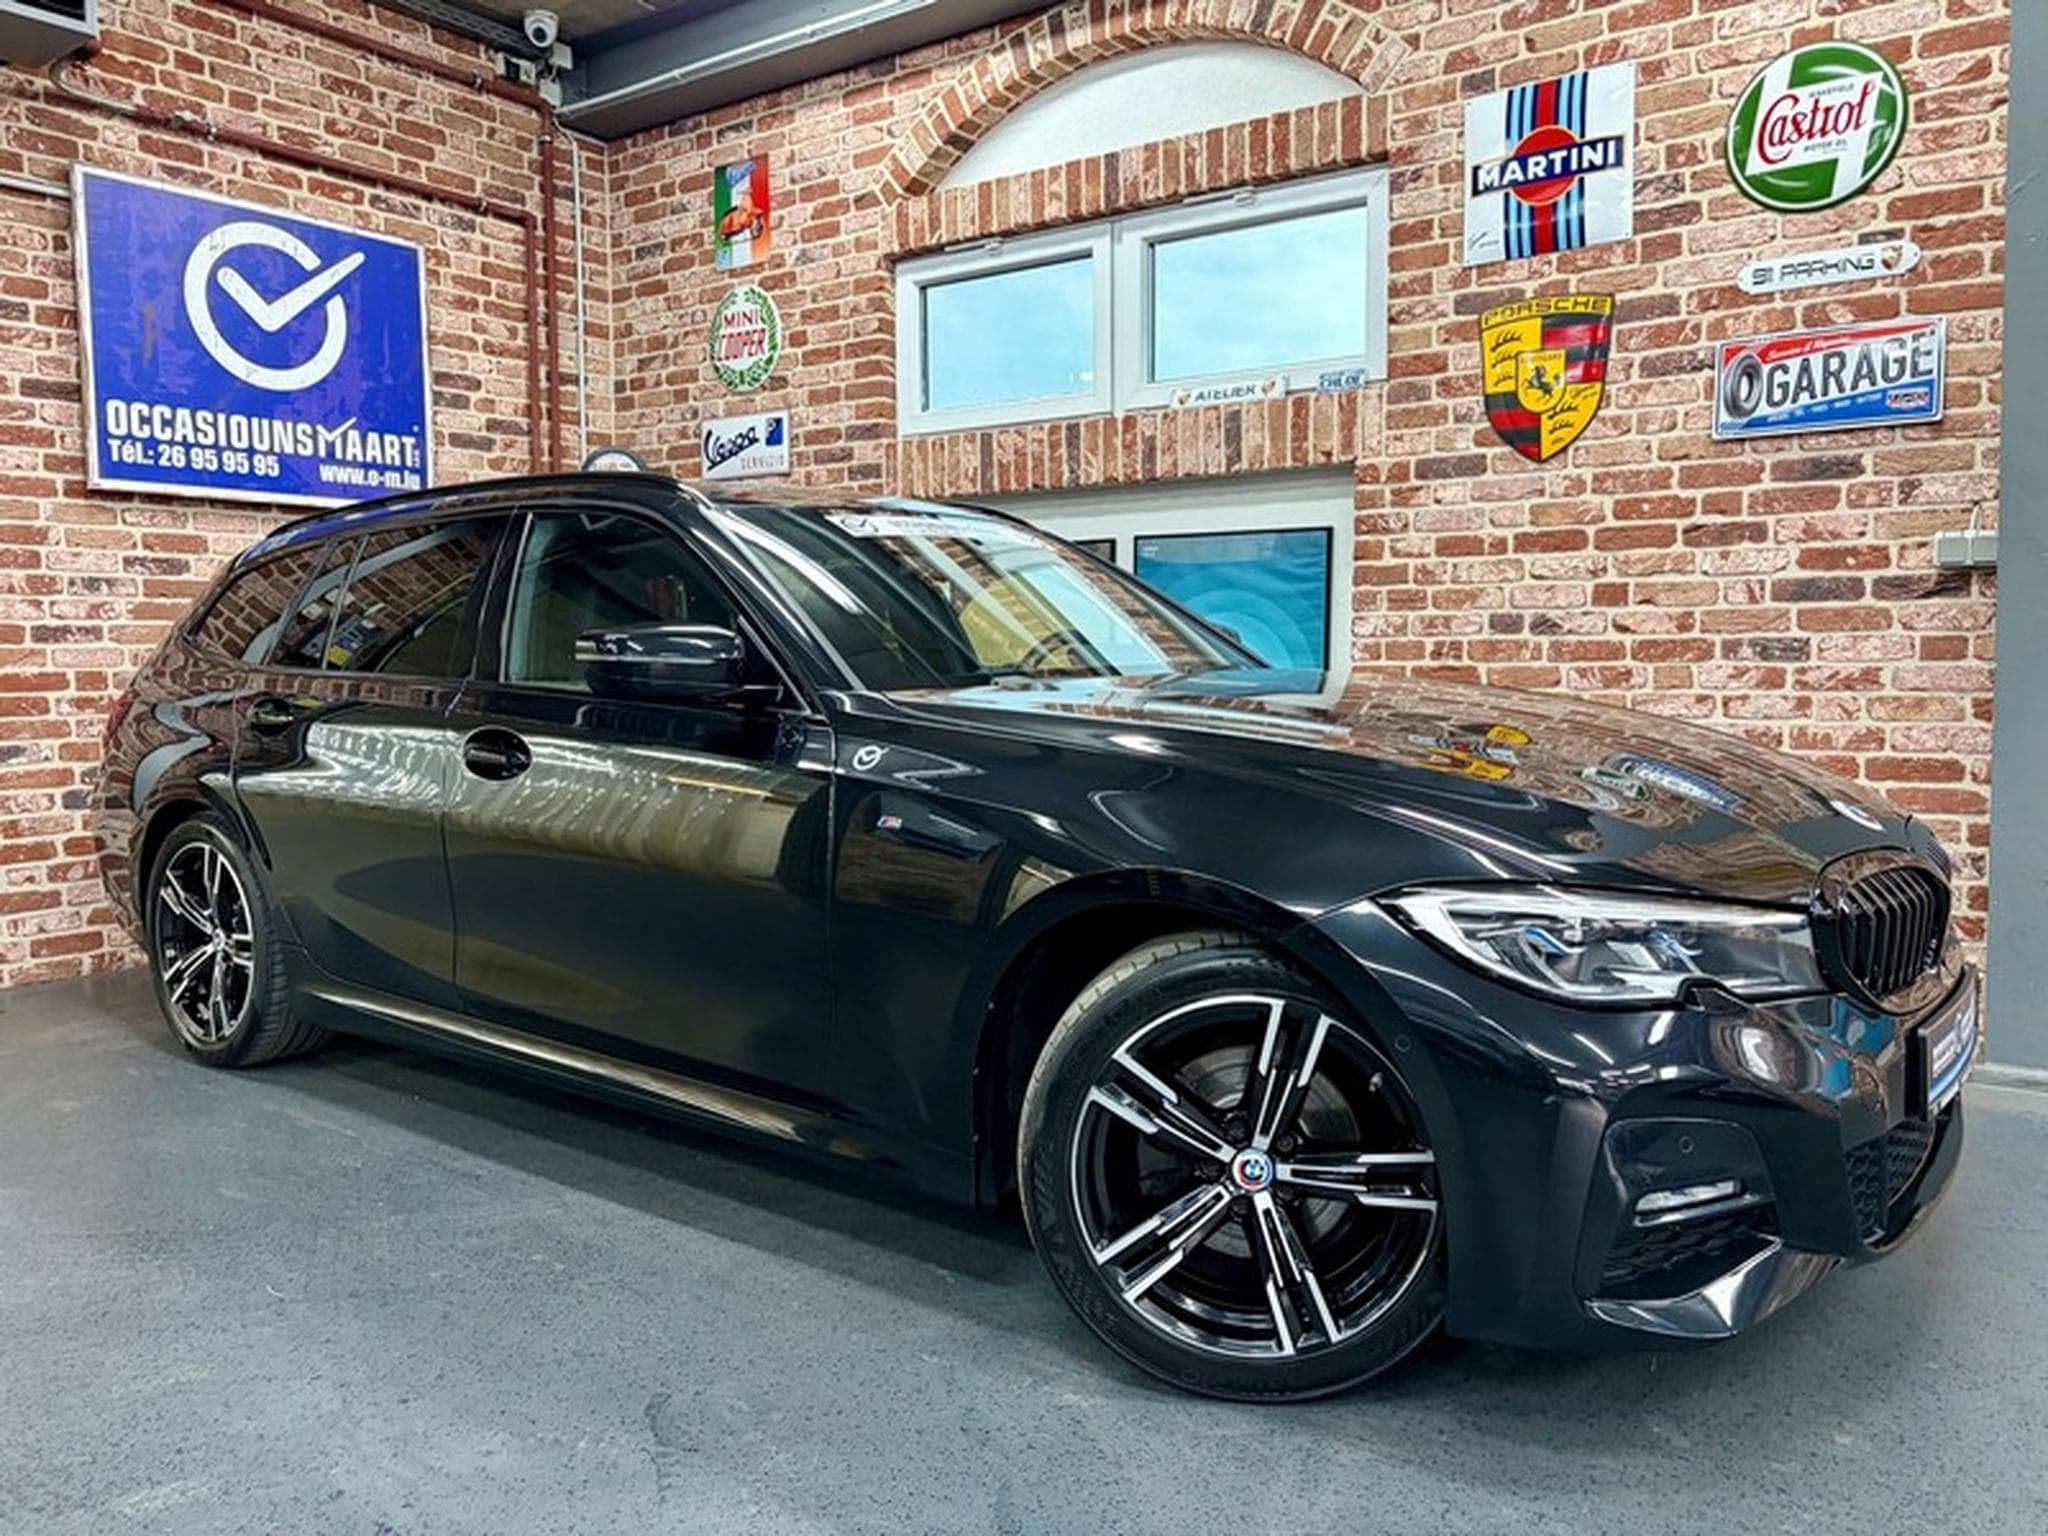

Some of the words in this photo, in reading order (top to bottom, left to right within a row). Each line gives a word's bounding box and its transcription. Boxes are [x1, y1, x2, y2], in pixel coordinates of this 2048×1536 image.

[1757, 80, 1877, 165] Castrol
[1477, 140, 1617, 191] MARTINI
[1780, 253, 1875, 281] PARKING
[724, 308, 760, 328] MINI
[1484, 298, 1609, 326] PORSCHE
[717, 327, 766, 362] COOPER
[1766, 330, 1934, 410] GARAGE
[105, 398, 417, 468] OCCASIOUNSMAART
[704, 428, 760, 472] Vespa
[158, 443, 186, 469] 26
[190, 447, 219, 472] 95
[222, 450, 250, 475] 95
[253, 453, 280, 477] 95
